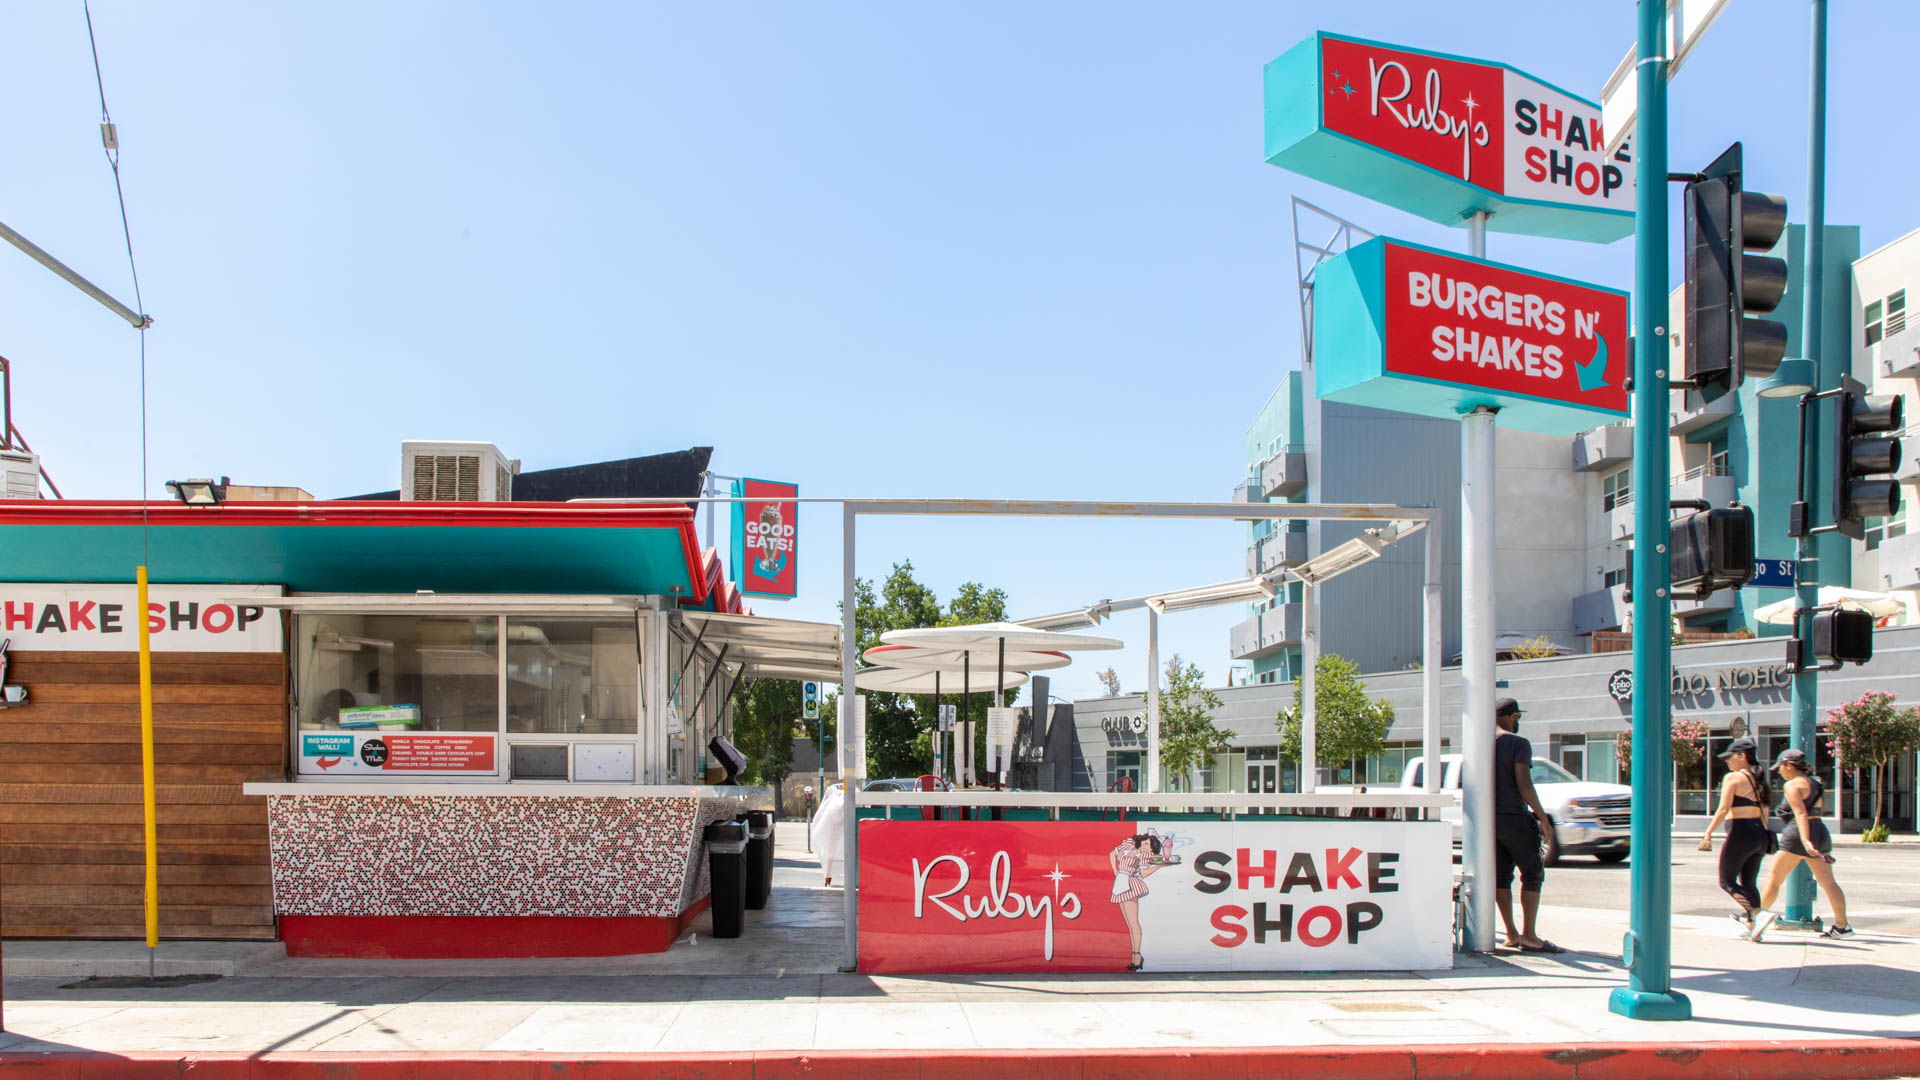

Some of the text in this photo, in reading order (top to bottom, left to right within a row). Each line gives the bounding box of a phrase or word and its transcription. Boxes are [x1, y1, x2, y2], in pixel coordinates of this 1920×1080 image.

[1369, 57, 1489, 182] Ruby's
[1525, 146, 1622, 199] SHOP
[1408, 271, 1600, 340] BURGERS N'
[1431, 325, 1564, 380] SHAKES
[745, 521, 794, 537] GOOD
[746, 535, 793, 552] EATS!
[1779, 560, 1792, 576] St
[0, 600, 264, 633] HAKE SHOP
[1715, 666, 1792, 691] NOHO
[1101, 715, 1132, 731] CLUB
[1193, 847, 1399, 893] SHAKE
[912, 850, 1082, 961] Ruby's
[1210, 901, 1383, 948] SHOP
